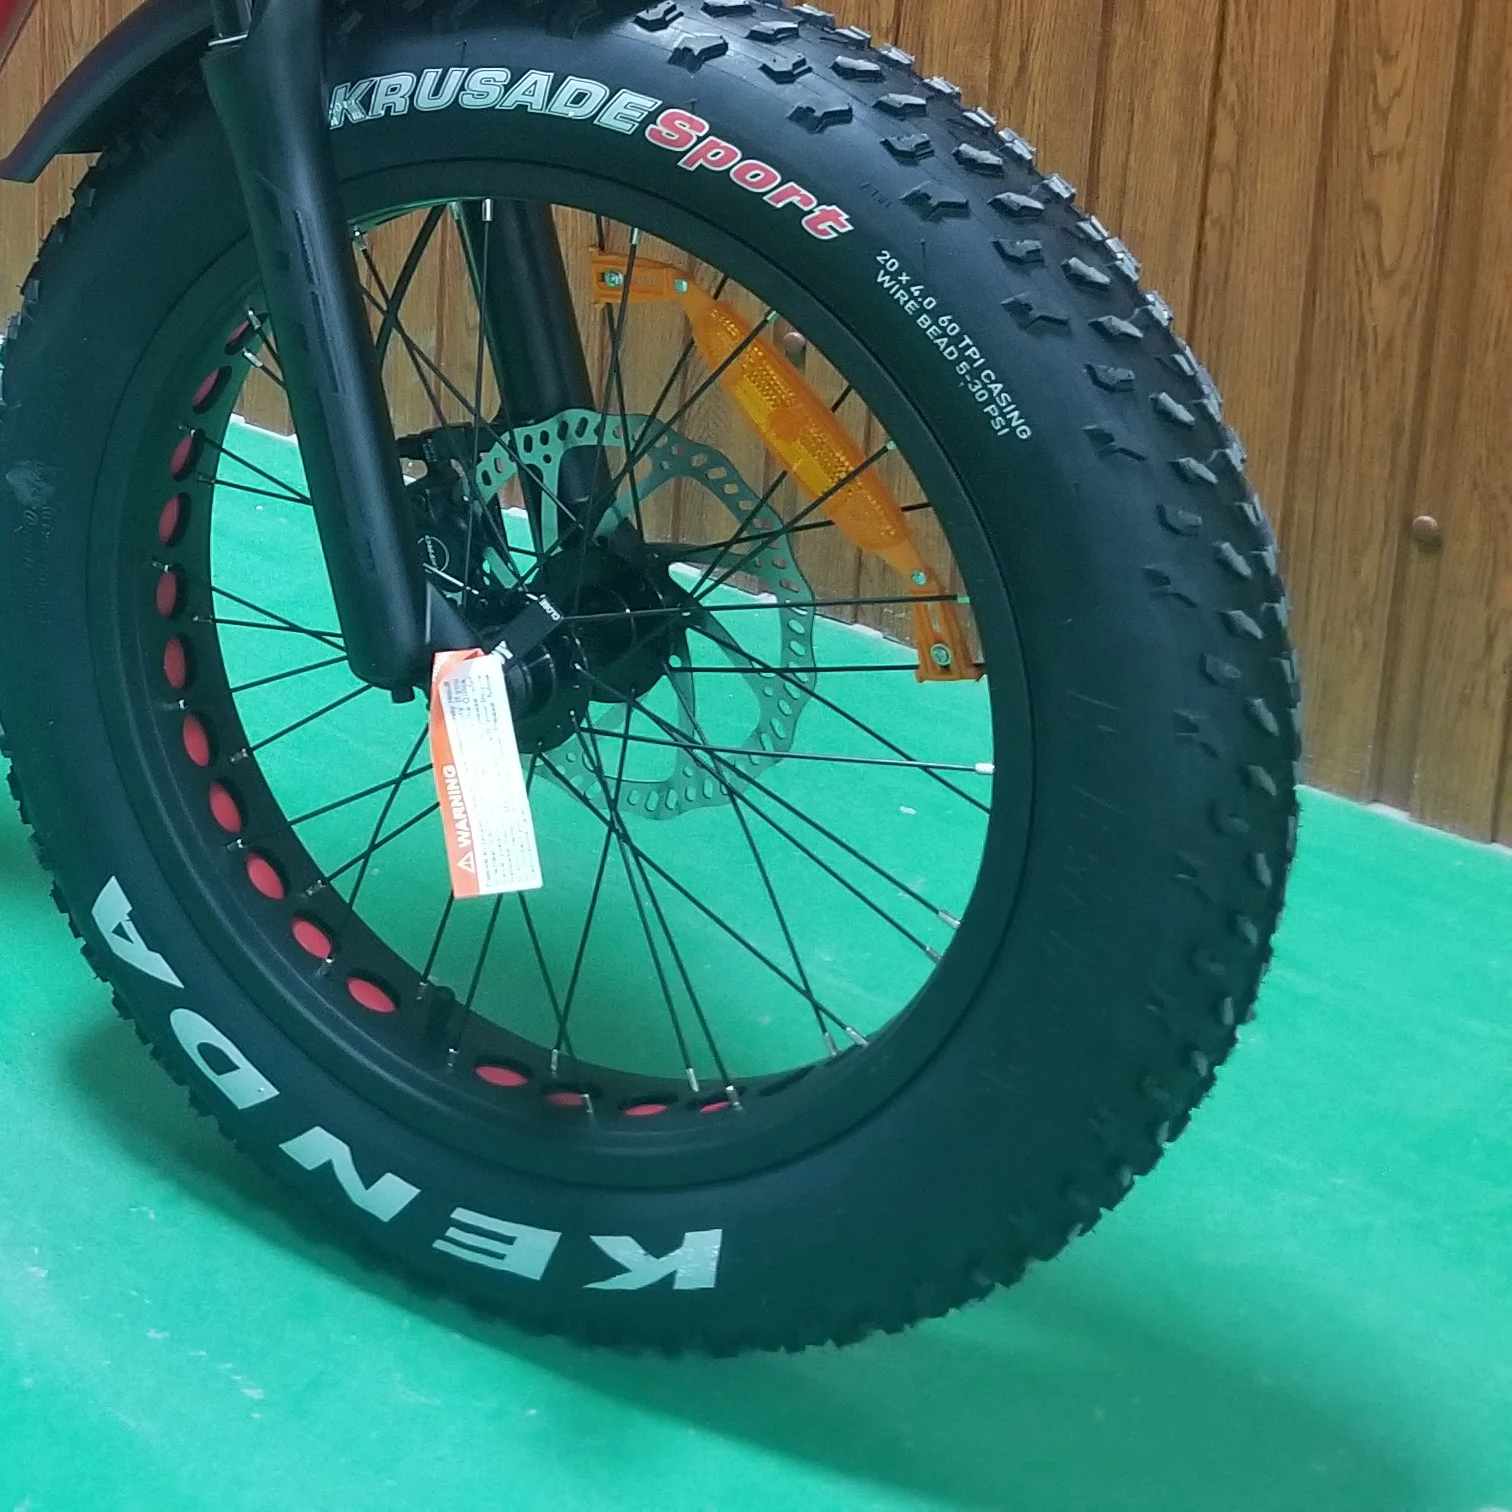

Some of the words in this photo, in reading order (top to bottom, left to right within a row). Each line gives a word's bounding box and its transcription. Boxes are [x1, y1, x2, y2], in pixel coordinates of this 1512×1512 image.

[329, 67, 662, 134] KRUSADE
[645, 108, 854, 240] Sport
[876, 250, 899, 272] 20
[909, 285, 937, 310] 4.0
[938, 314, 960, 336] 60
[958, 334, 986, 368] TPI
[980, 369, 1032, 440] CASING
[876, 269, 920, 315] WIRE
[916, 313, 958, 361] BEAD
[956, 361, 989, 402] 5-30
[983, 404, 1010, 436] PSI
[442, 764, 472, 848] WARNING
[92, 876, 723, 1289] KENDA
